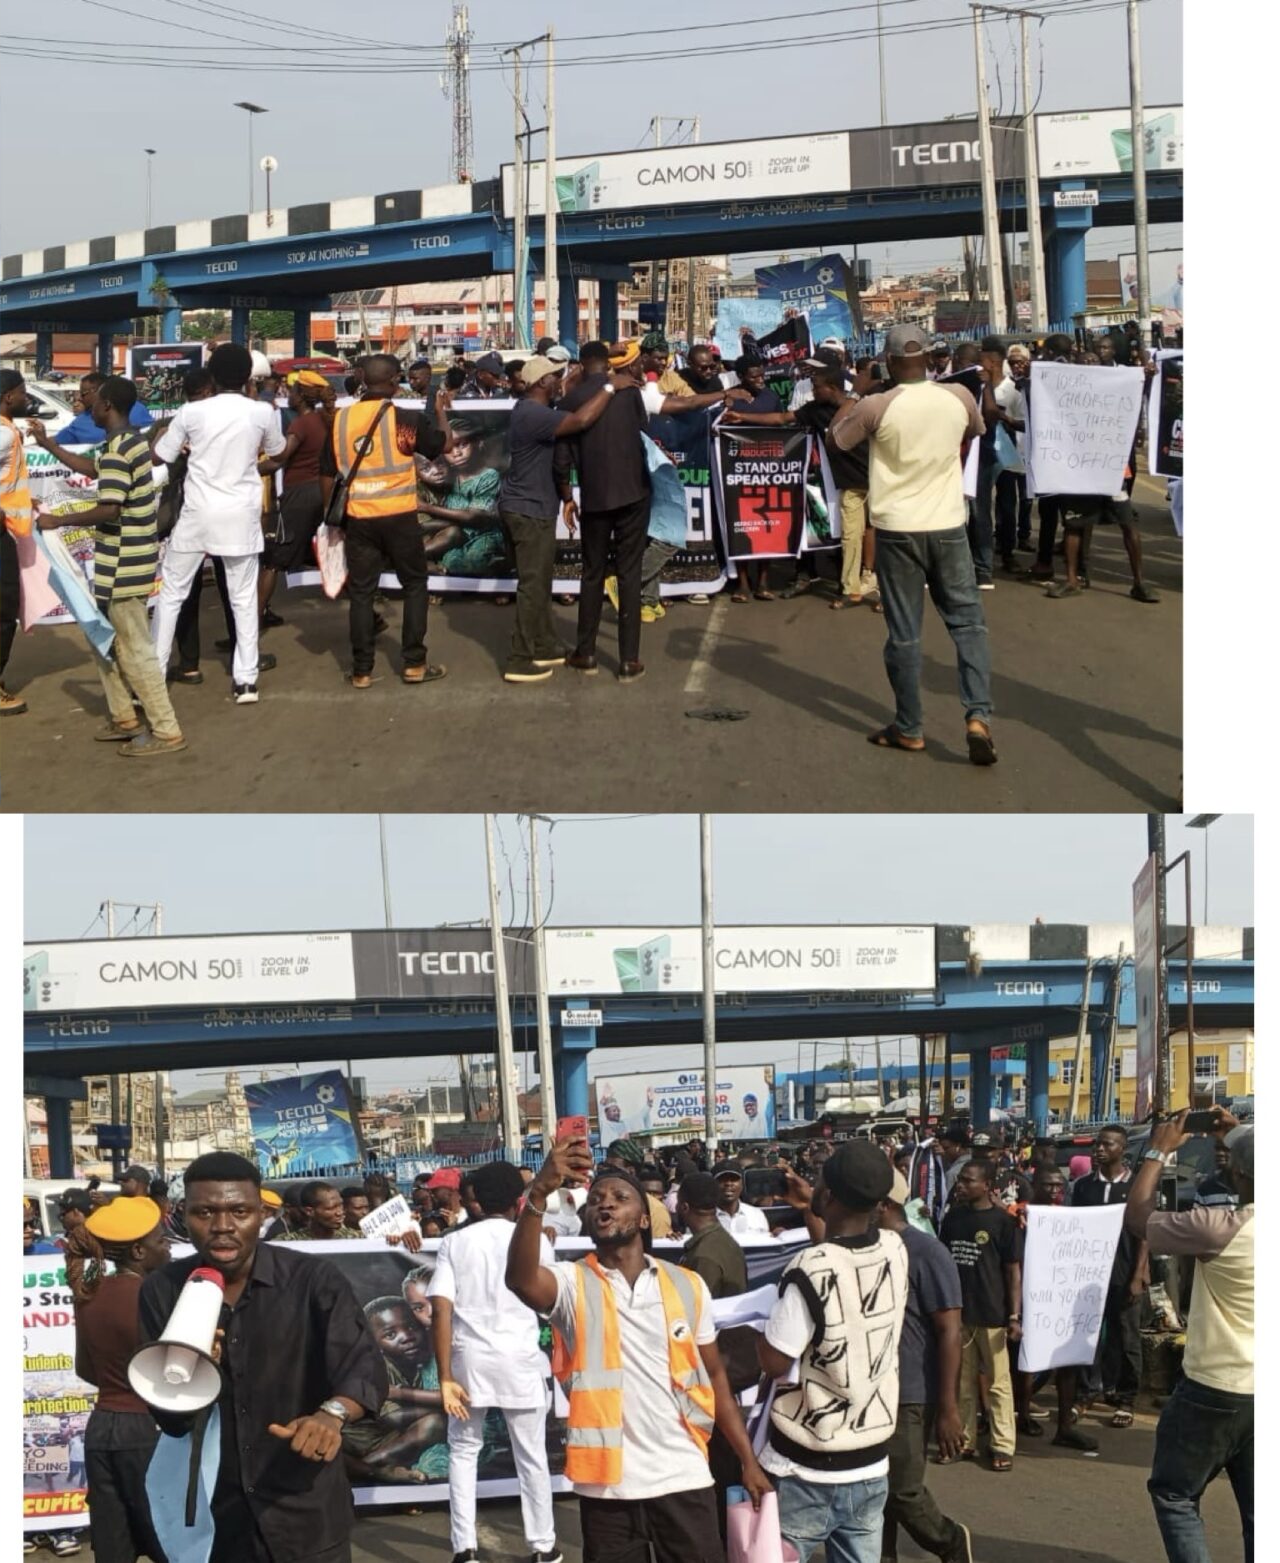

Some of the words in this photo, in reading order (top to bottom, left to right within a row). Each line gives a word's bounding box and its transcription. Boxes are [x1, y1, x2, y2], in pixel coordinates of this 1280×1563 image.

[768, 156, 796, 167] ZOOM
[636, 163, 716, 186] CAMON
[723, 160, 748, 179] 50
[768, 165, 794, 176] LEVEL
[797, 163, 811, 173] UP
[411, 235, 451, 250] TECNO
[287, 252, 306, 265] STOP
[307, 251, 318, 263] AT
[319, 245, 356, 262] NOTHING
[206, 260, 238, 275] TECNO
[100, 275, 123, 289] TECNO
[780, 283, 825, 302] TECNO
[1039, 447, 1062, 461] TO
[735, 461, 779, 474] STAND
[781, 460, 802, 473] UP!
[726, 474, 772, 486] SPEAK
[773, 472, 802, 485] OUT!
[260, 956, 294, 967] ZOOM
[715, 949, 802, 970] CAMON
[810, 948, 835, 968] 50
[856, 957, 882, 966] LEVEL
[99, 959, 198, 984] CAMON
[207, 958, 236, 980] 50
[260, 966, 292, 977] LEVEL
[295, 965, 310, 975] UP
[994, 981, 1045, 996] TECNO
[659, 1096, 698, 1108] AJADI
[275, 1103, 326, 1121] TECNO
[1033, 1312, 1052, 1330] TO
